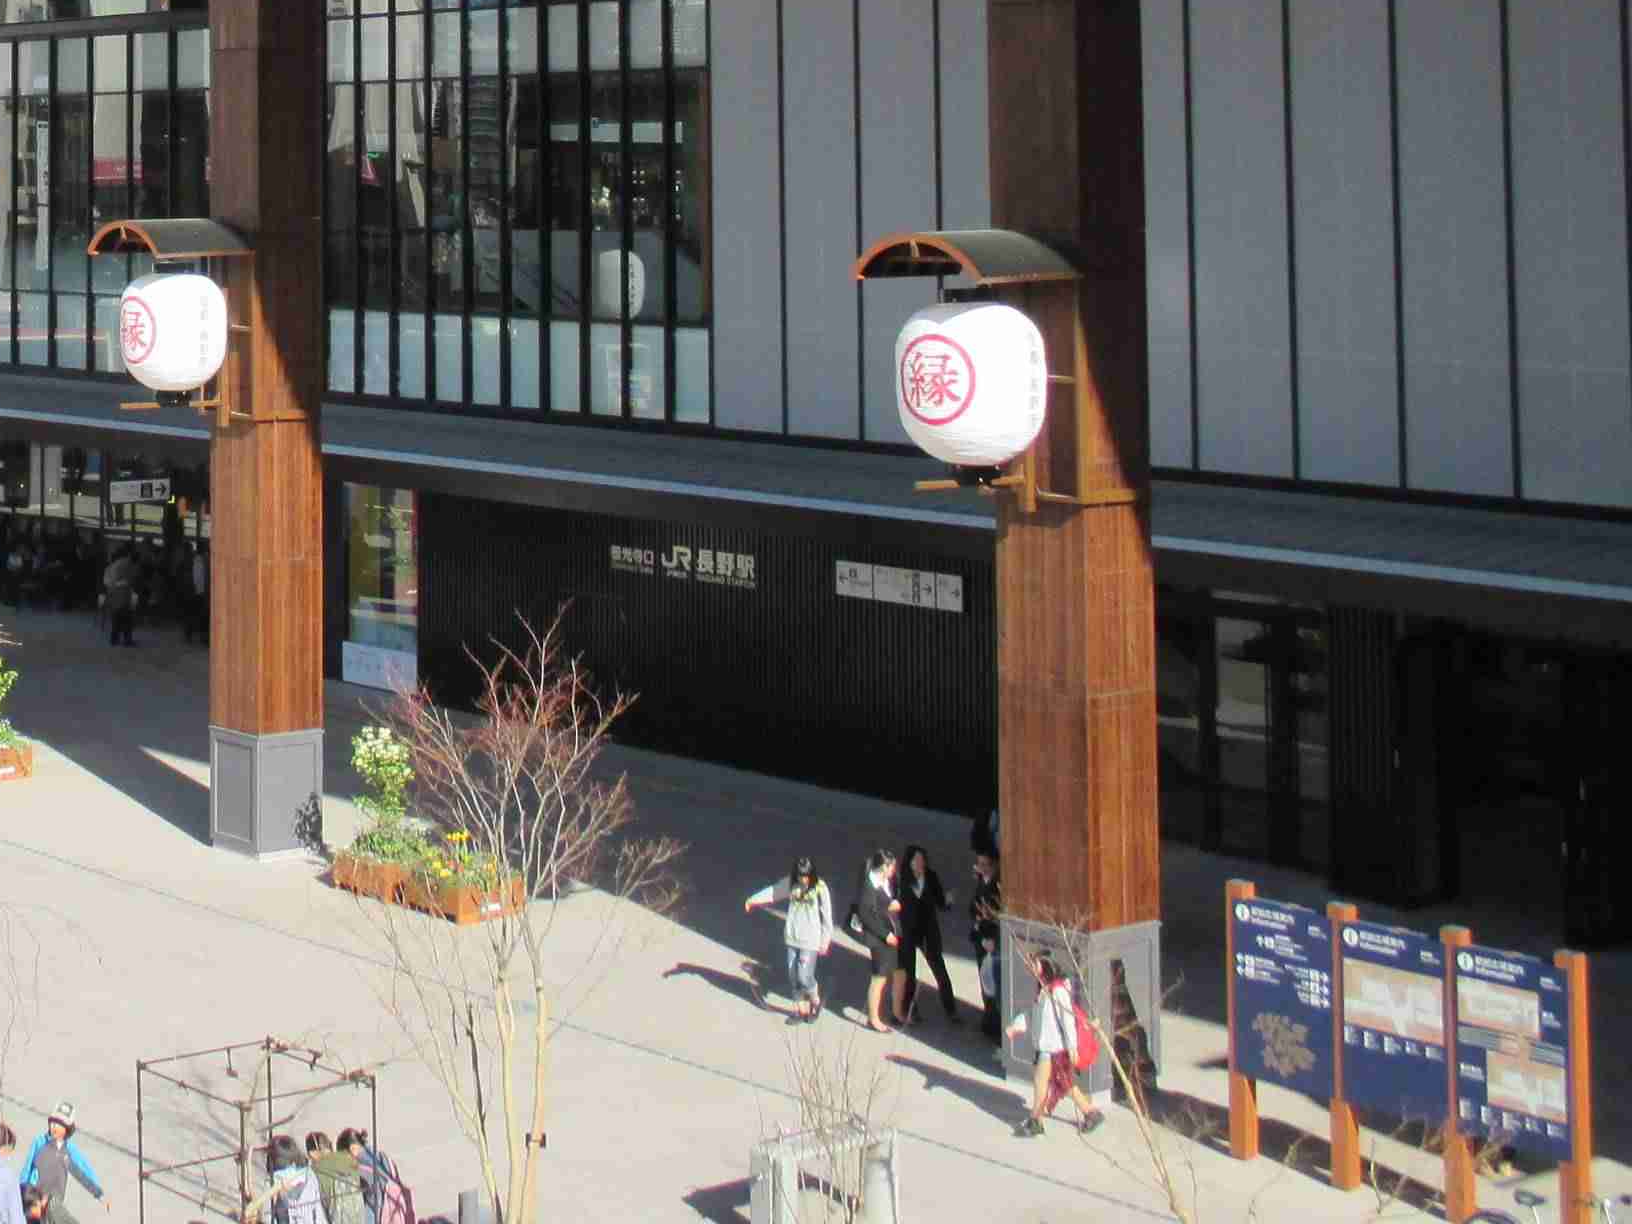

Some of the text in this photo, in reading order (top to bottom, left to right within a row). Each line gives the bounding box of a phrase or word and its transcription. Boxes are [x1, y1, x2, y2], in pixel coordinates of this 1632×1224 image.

[908, 351, 962, 408] 縁
[661, 545, 692, 571] JR
[697, 549, 755, 579] 長野駅
